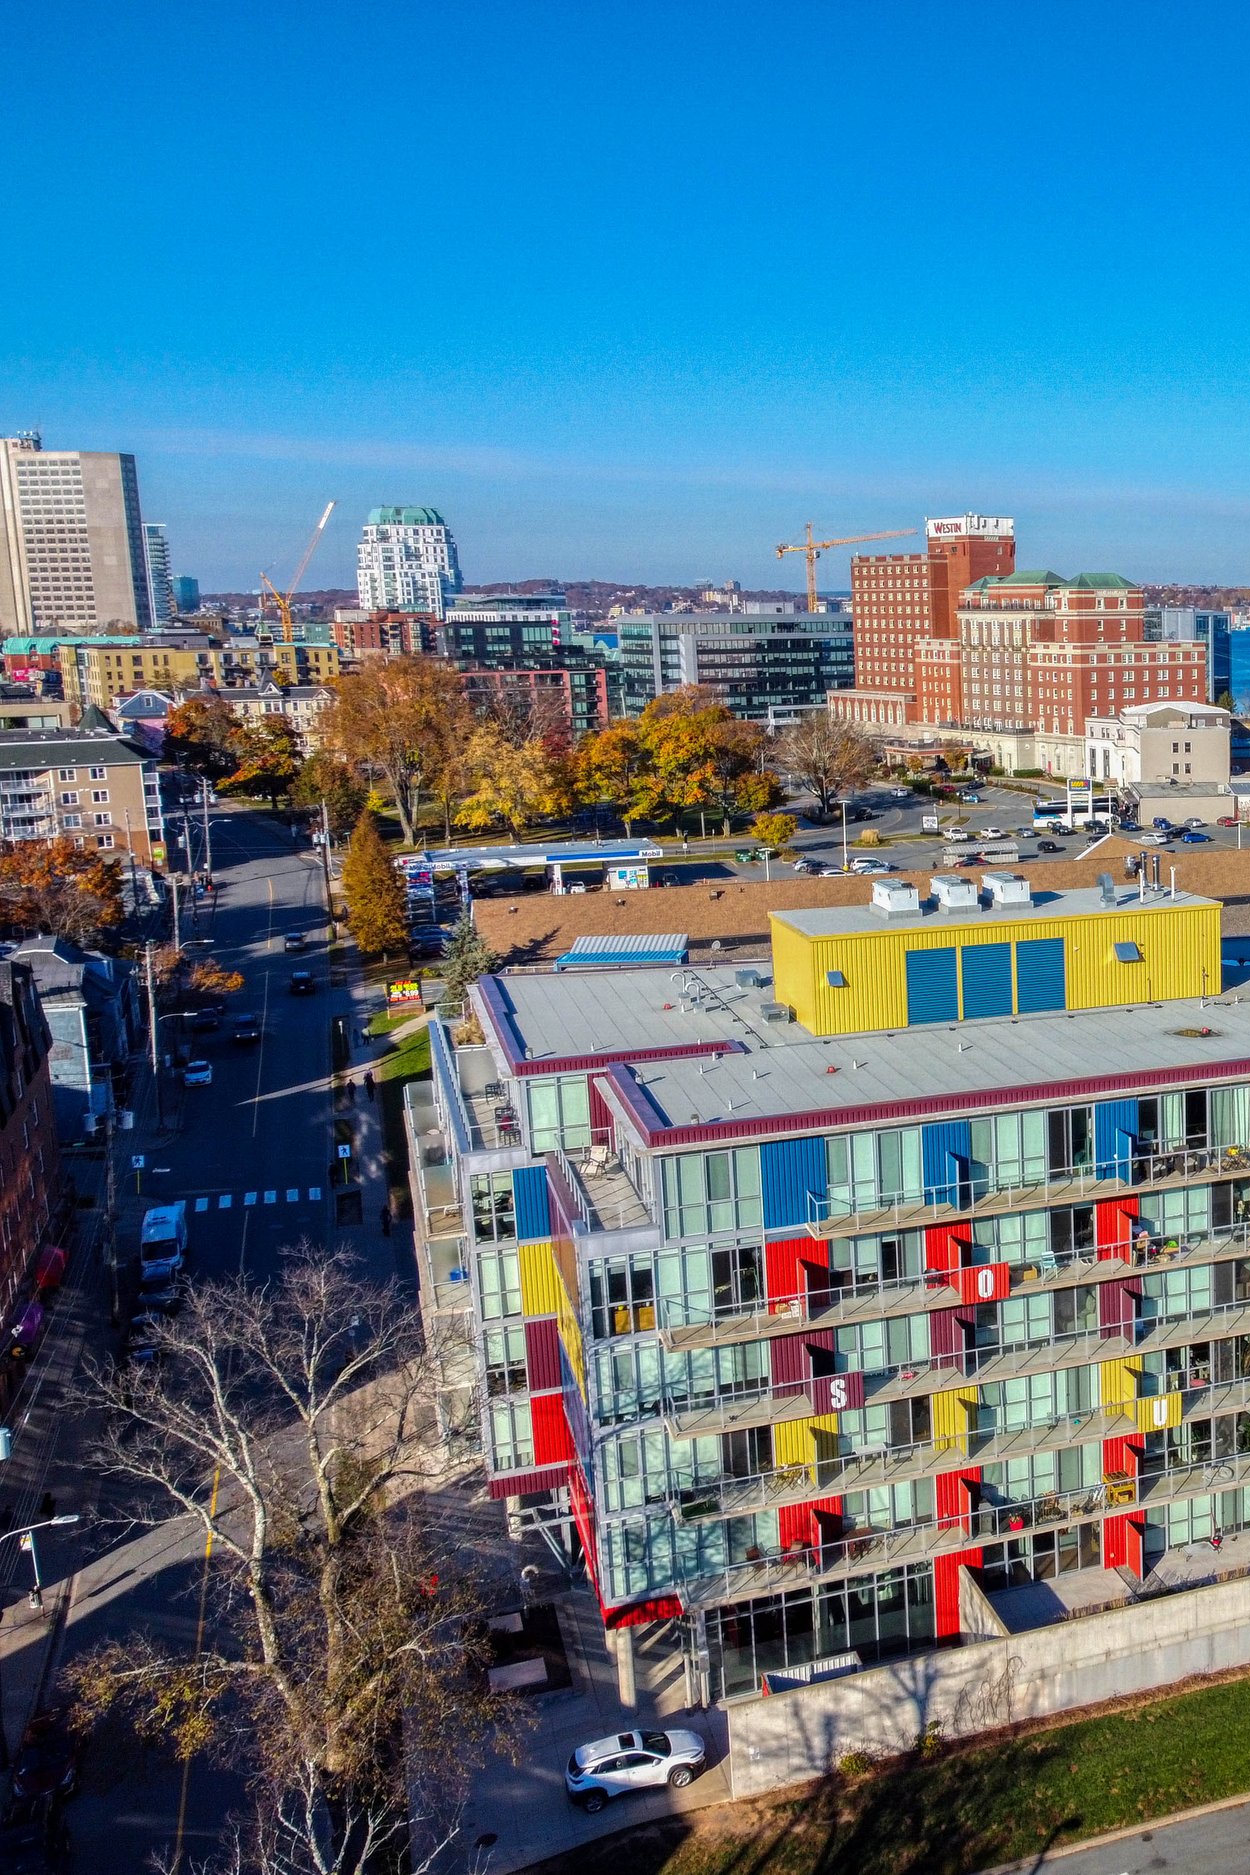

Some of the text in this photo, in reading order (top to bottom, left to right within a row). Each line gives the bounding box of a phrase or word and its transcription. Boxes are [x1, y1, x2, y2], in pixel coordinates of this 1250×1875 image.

[934, 522, 962, 534] WESTIN
[431, 862, 451, 870] Mobil
[978, 1269, 994, 1298] O
[830, 1379, 847, 1409] S
[1153, 1398, 1168, 1426] U
